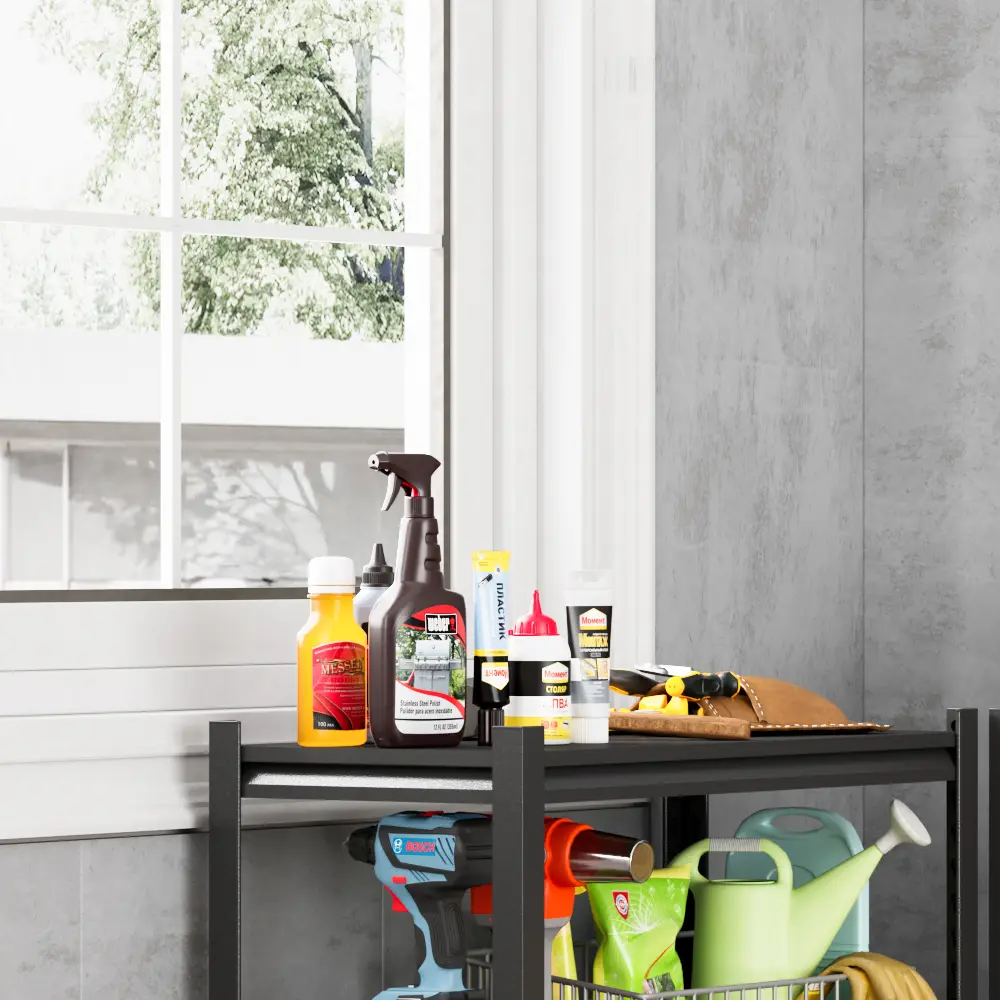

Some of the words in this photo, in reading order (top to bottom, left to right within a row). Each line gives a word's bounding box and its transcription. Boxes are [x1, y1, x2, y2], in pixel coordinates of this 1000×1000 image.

[496, 582, 506, 640] ПЛАСТИК
[581, 616, 605, 625] Момент
[552, 698, 568, 709] ПВА
[405, 840, 436, 853] BOSCH
